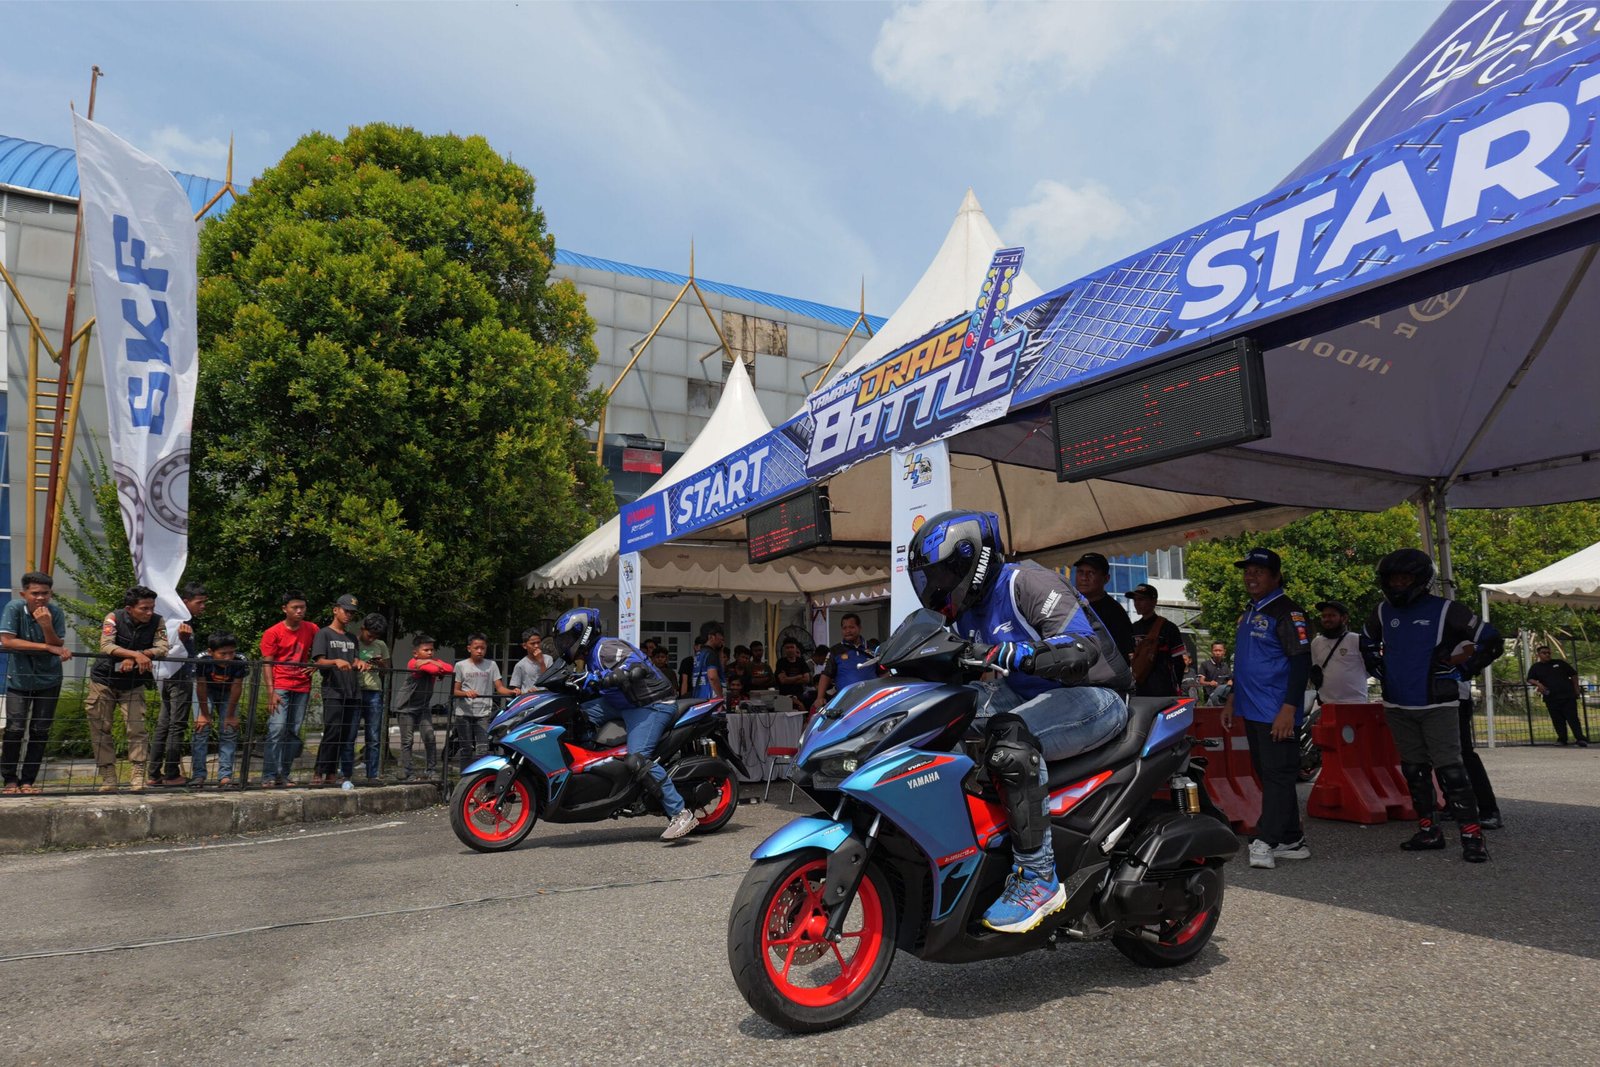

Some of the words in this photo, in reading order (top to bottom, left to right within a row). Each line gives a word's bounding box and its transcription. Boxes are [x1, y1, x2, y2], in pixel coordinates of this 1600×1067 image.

[1477, 8, 1600, 84] CR
[1179, 74, 1600, 320] STAR
[112, 214, 171, 435] SKF
[807, 331, 1023, 469] BATTLE
[811, 376, 861, 411] YAMAHA
[857, 319, 971, 407] DRAG
[677, 446, 772, 525] START
[972, 546, 991, 584] YAMAHA
[580, 625, 592, 645] YAMAHA
[907, 771, 940, 789] YAMAHA
